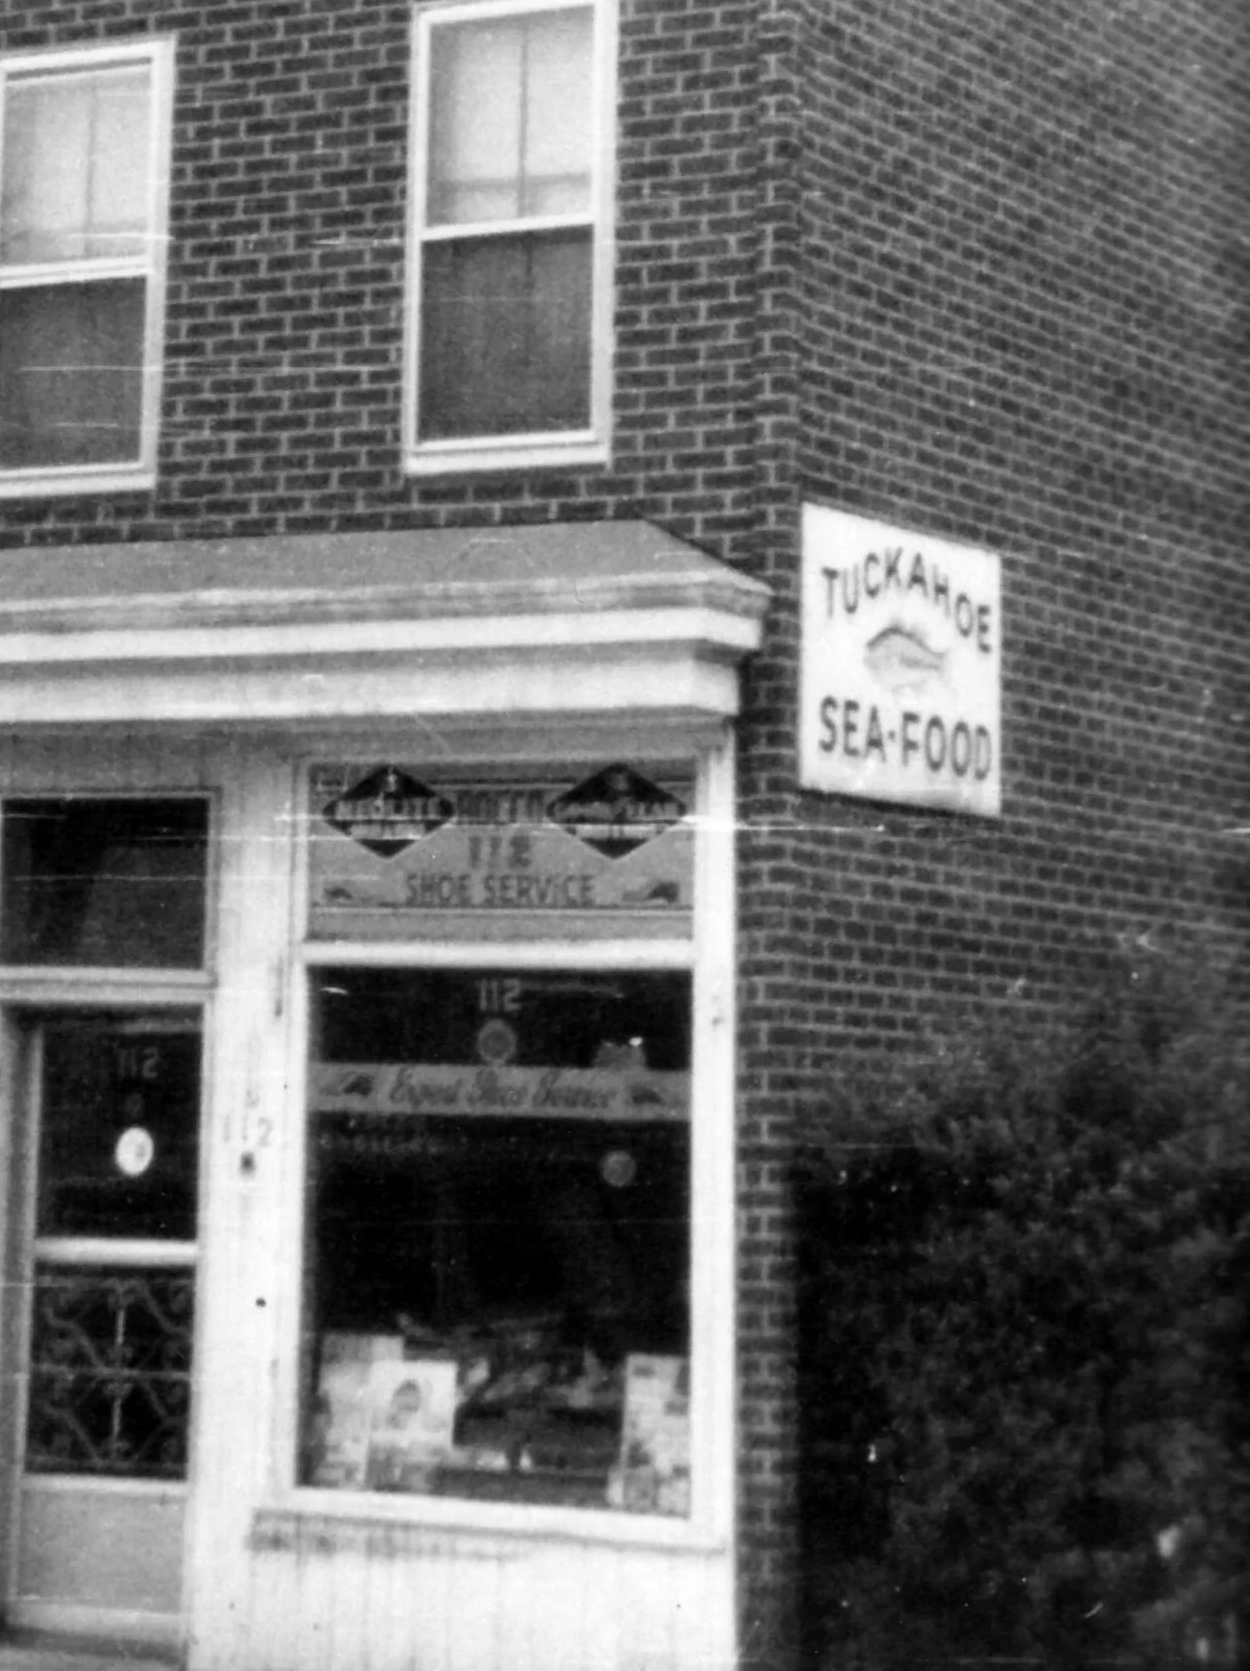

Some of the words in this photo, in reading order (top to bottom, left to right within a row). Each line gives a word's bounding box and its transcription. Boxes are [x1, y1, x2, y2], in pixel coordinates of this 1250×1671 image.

[821, 547, 991, 655] TUCKAHOE
[405, 873, 471, 907] SHOE
[483, 873, 596, 907] SERVICE
[477, 978, 521, 1012] 112
